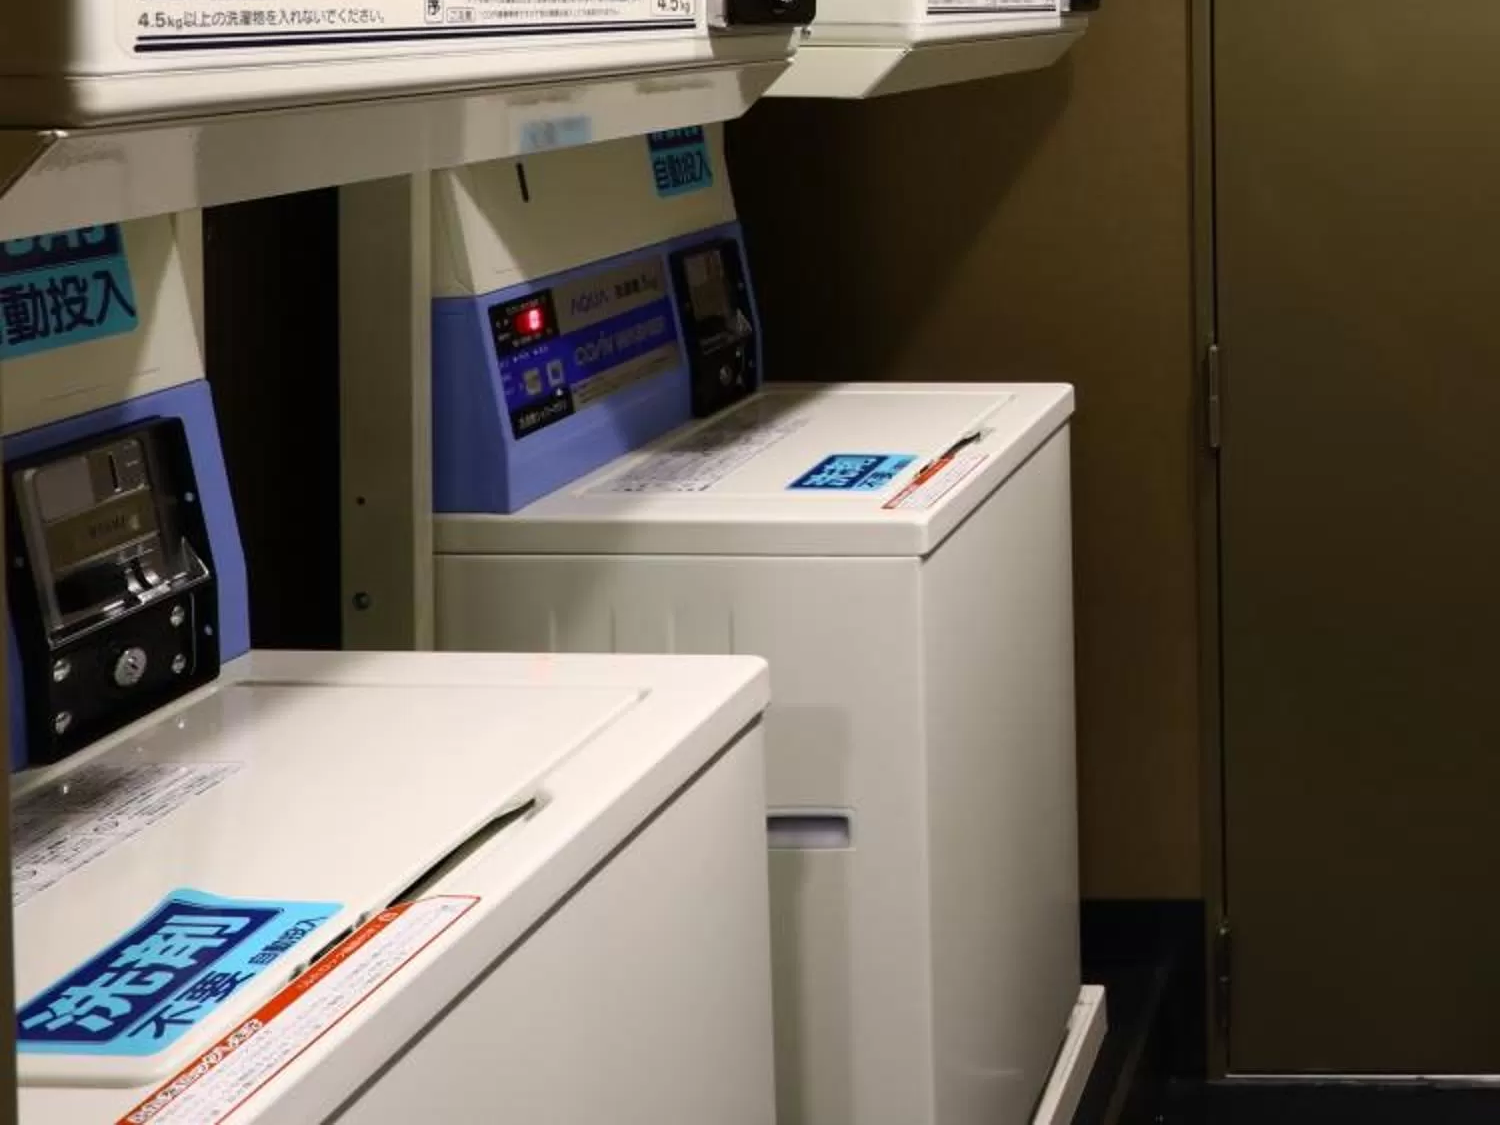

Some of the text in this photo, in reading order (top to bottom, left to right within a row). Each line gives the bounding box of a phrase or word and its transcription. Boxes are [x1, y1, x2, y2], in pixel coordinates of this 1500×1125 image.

[0, 270, 137, 346] 動投入
[22, 915, 251, 1033] 洗剤
[128, 915, 329, 1040] 不要 自動投入
